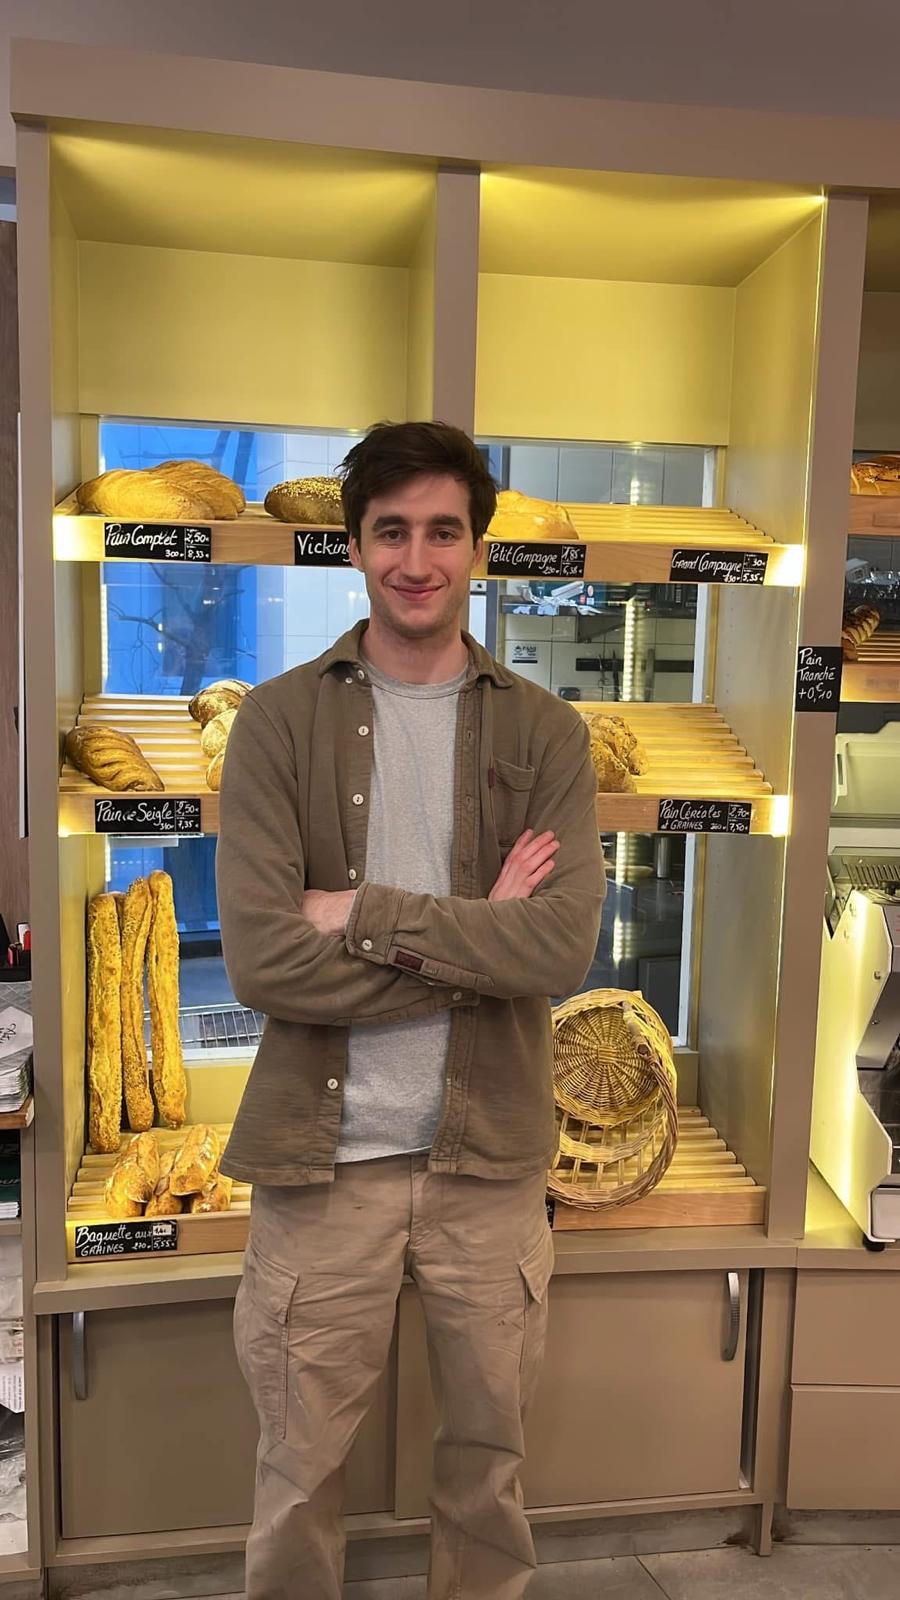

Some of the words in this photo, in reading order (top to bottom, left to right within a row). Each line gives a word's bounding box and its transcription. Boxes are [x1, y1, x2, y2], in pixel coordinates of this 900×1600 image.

[106, 523, 131, 546] Pain
[488, 543, 513, 563] Petit
[512, 545, 558, 569] Campagne
[672, 551, 699, 570] Grand
[698, 552, 742, 577] Campagne
[799, 647, 822, 666] Pain
[797, 666, 836, 681] Tranché
[96, 800, 122, 822] Pain
[136, 802, 174, 826] Seigle
[660, 799, 679, 819] Pain
[680, 801, 721, 820] Céréales
[670, 819, 703, 830] GRAINES
[75, 1224, 133, 1249] Baguette
[135, 1230, 152, 1238] aux
[81, 1242, 124, 1256] GRAINES
